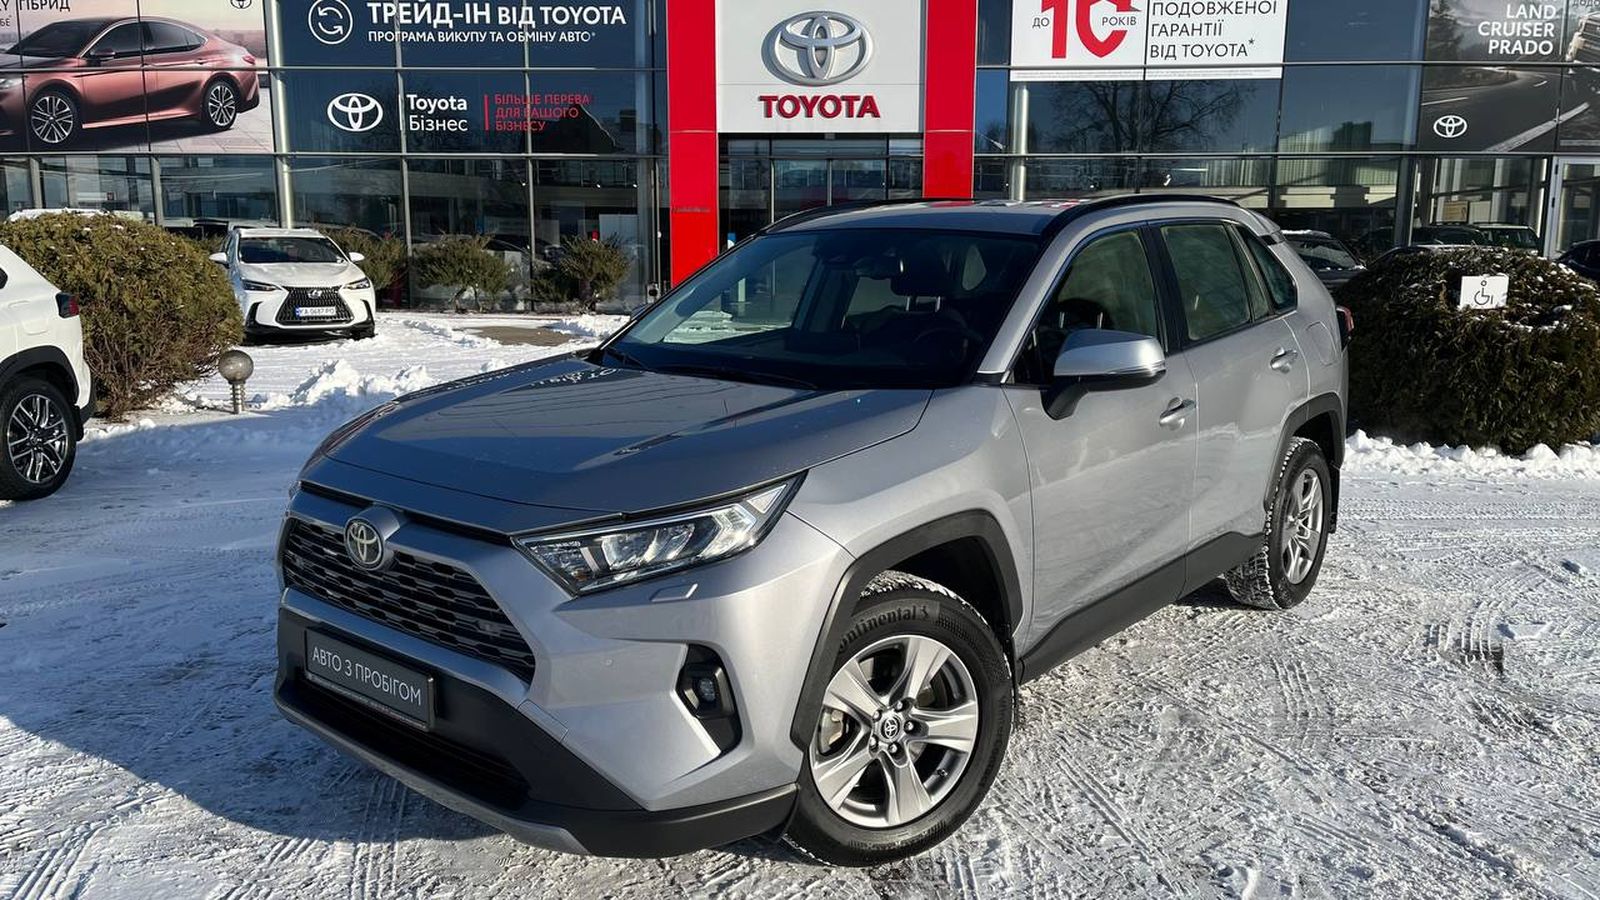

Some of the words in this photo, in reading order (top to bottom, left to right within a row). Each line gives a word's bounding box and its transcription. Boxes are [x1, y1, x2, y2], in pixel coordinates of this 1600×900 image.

[20, 0, 70, 12] ГІБРИД
[367, 0, 490, 28] ТРЕЙД-ІН
[498, 6, 535, 28] ВІД
[540, 6, 626, 25] TOYOTA
[1506, 4, 1556, 20] LAND
[1032, 17, 1050, 28] ДО
[1102, 16, 1137, 26] РОКІВ
[1151, 20, 1224, 37] ГАРАНТІЇ
[1478, 21, 1555, 37] CRUISER
[368, 31, 435, 42] ПРОГРАМА
[438, 31, 487, 42] ВИКУПУ
[489, 31, 504, 42] ТА
[506, 31, 556, 42] ОБМІНУ
[1150, 44, 1177, 60] ВІД
[1488, 39, 1554, 55] PRADO
[406, 94, 467, 114] Toyota
[494, 94, 541, 105] БІЛЬШЕ
[758, 94, 881, 118] TOYOTA
[496, 107, 520, 118] ДЛЯ
[409, 115, 468, 131] Бізнес
[495, 121, 546, 131] БІЗНЕСУ
[839, 604, 917, 651] ontinental
[312, 646, 342, 672] АВТО
[344, 659, 353, 677] З
[355, 663, 421, 706] ПРОБІГОМ
